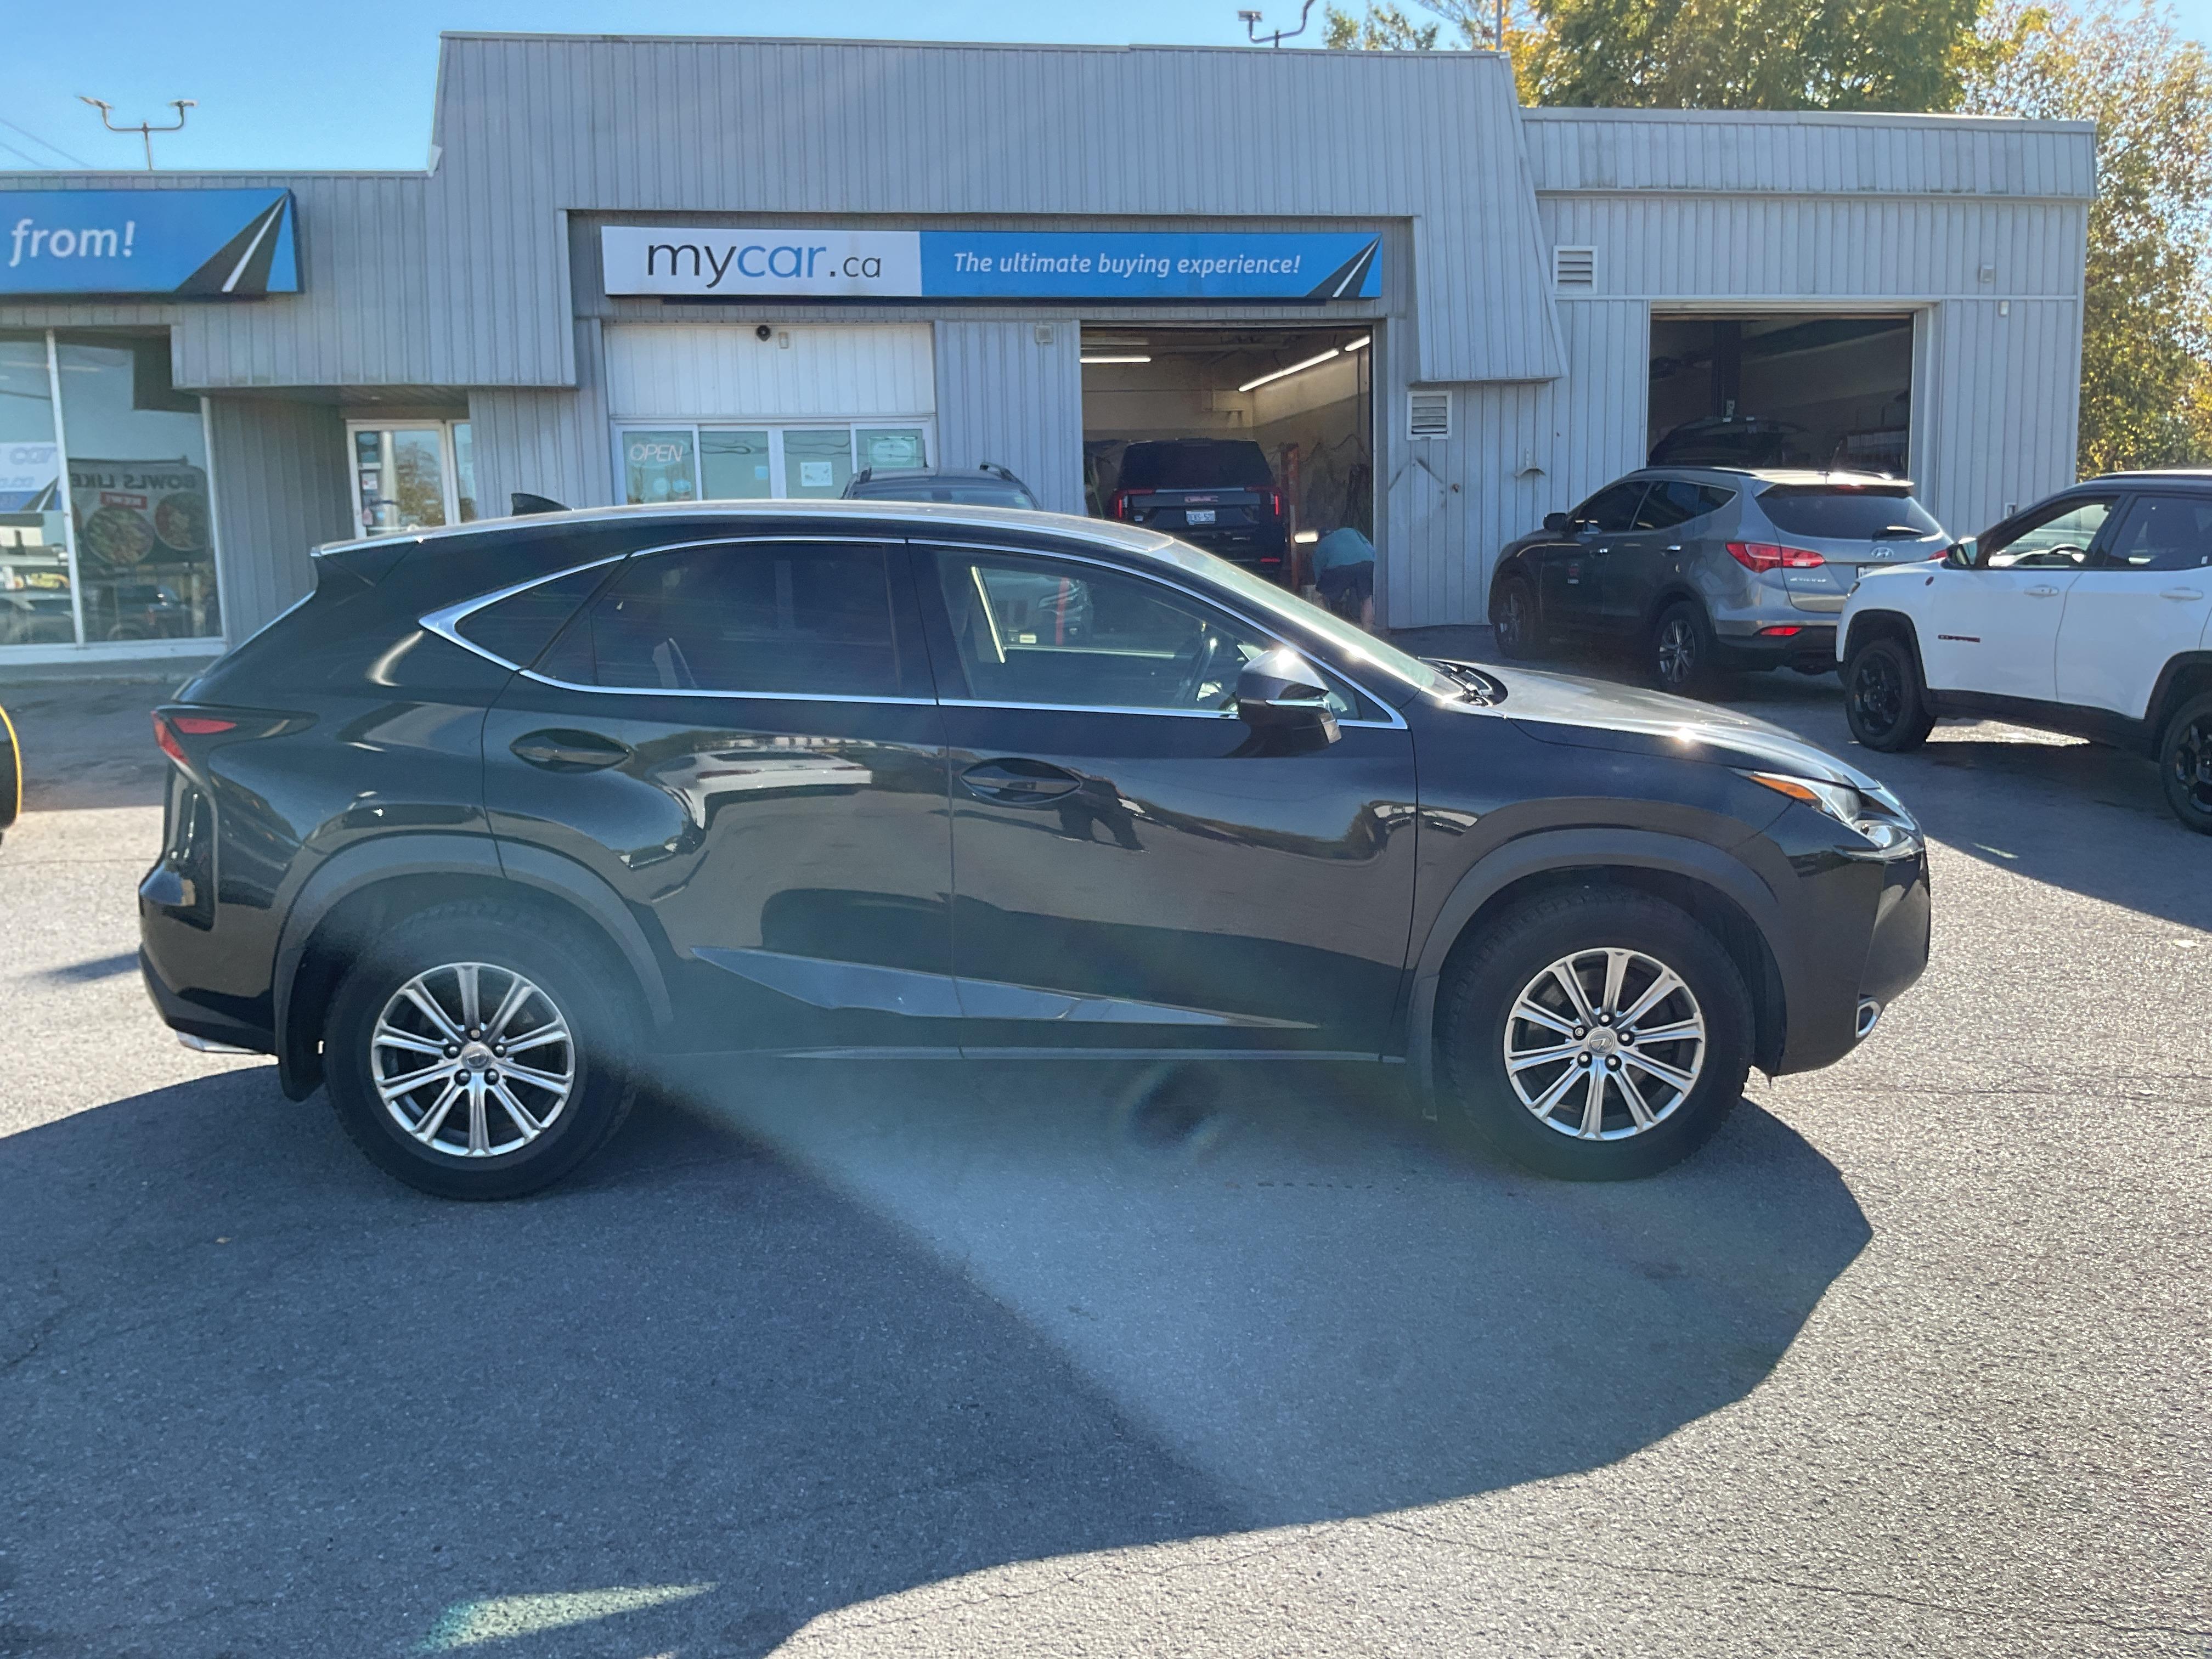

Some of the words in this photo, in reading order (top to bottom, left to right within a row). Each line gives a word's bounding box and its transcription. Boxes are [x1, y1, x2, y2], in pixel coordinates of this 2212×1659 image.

[9, 218, 136, 267] from!
[647, 244, 882, 289] mycar.ca
[953, 252, 992, 272] The
[1000, 252, 1092, 273] ultimate
[1098, 253, 1171, 278] buying
[1177, 254, 1301, 278] experience!
[630, 443, 683, 462] OPEN
